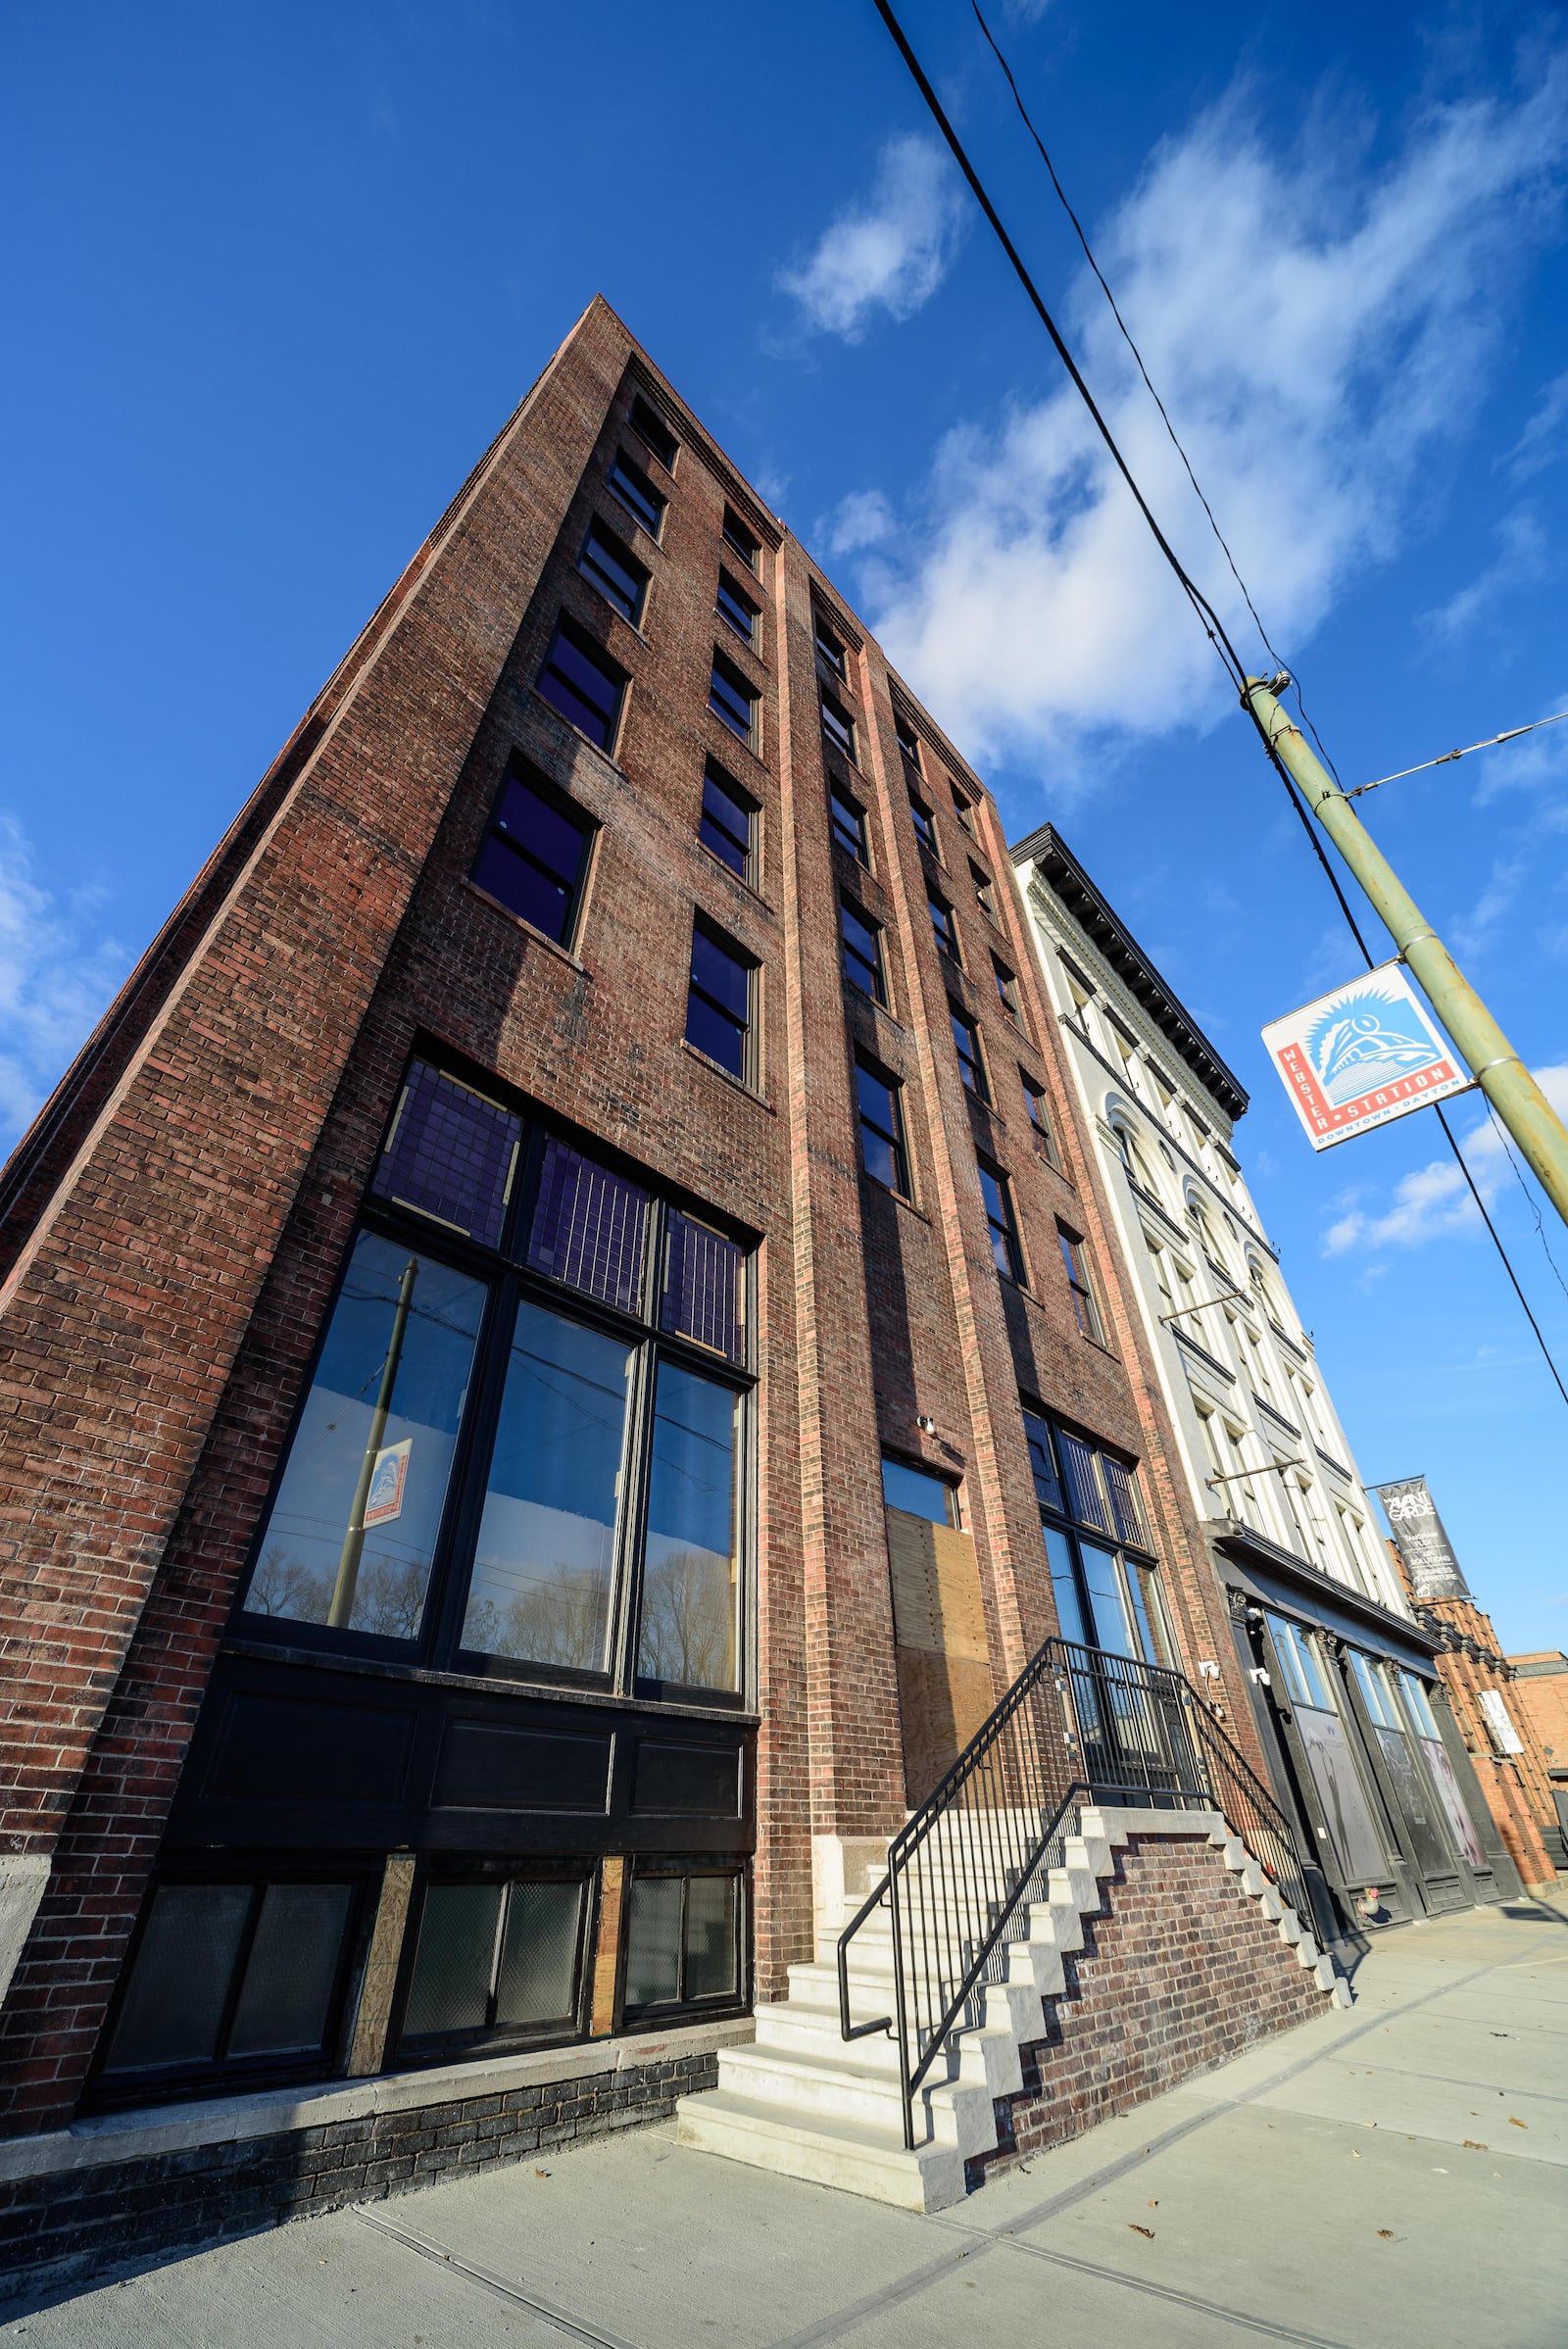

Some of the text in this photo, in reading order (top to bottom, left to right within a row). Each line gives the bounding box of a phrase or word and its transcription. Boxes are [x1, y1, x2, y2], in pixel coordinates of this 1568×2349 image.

[1283, 1049, 1329, 1130] WEBSTER
[1347, 1068, 1446, 1118] STATION
[1317, 1079, 1460, 1145] DOWNTOWN DAYTON
[1389, 1491, 1427, 1510] AVANT
[1389, 1503, 1436, 1521] GARDE
[1410, 1555, 1451, 1565] SOLUTIONS
[1415, 1574, 1459, 1583] FURNITURE
